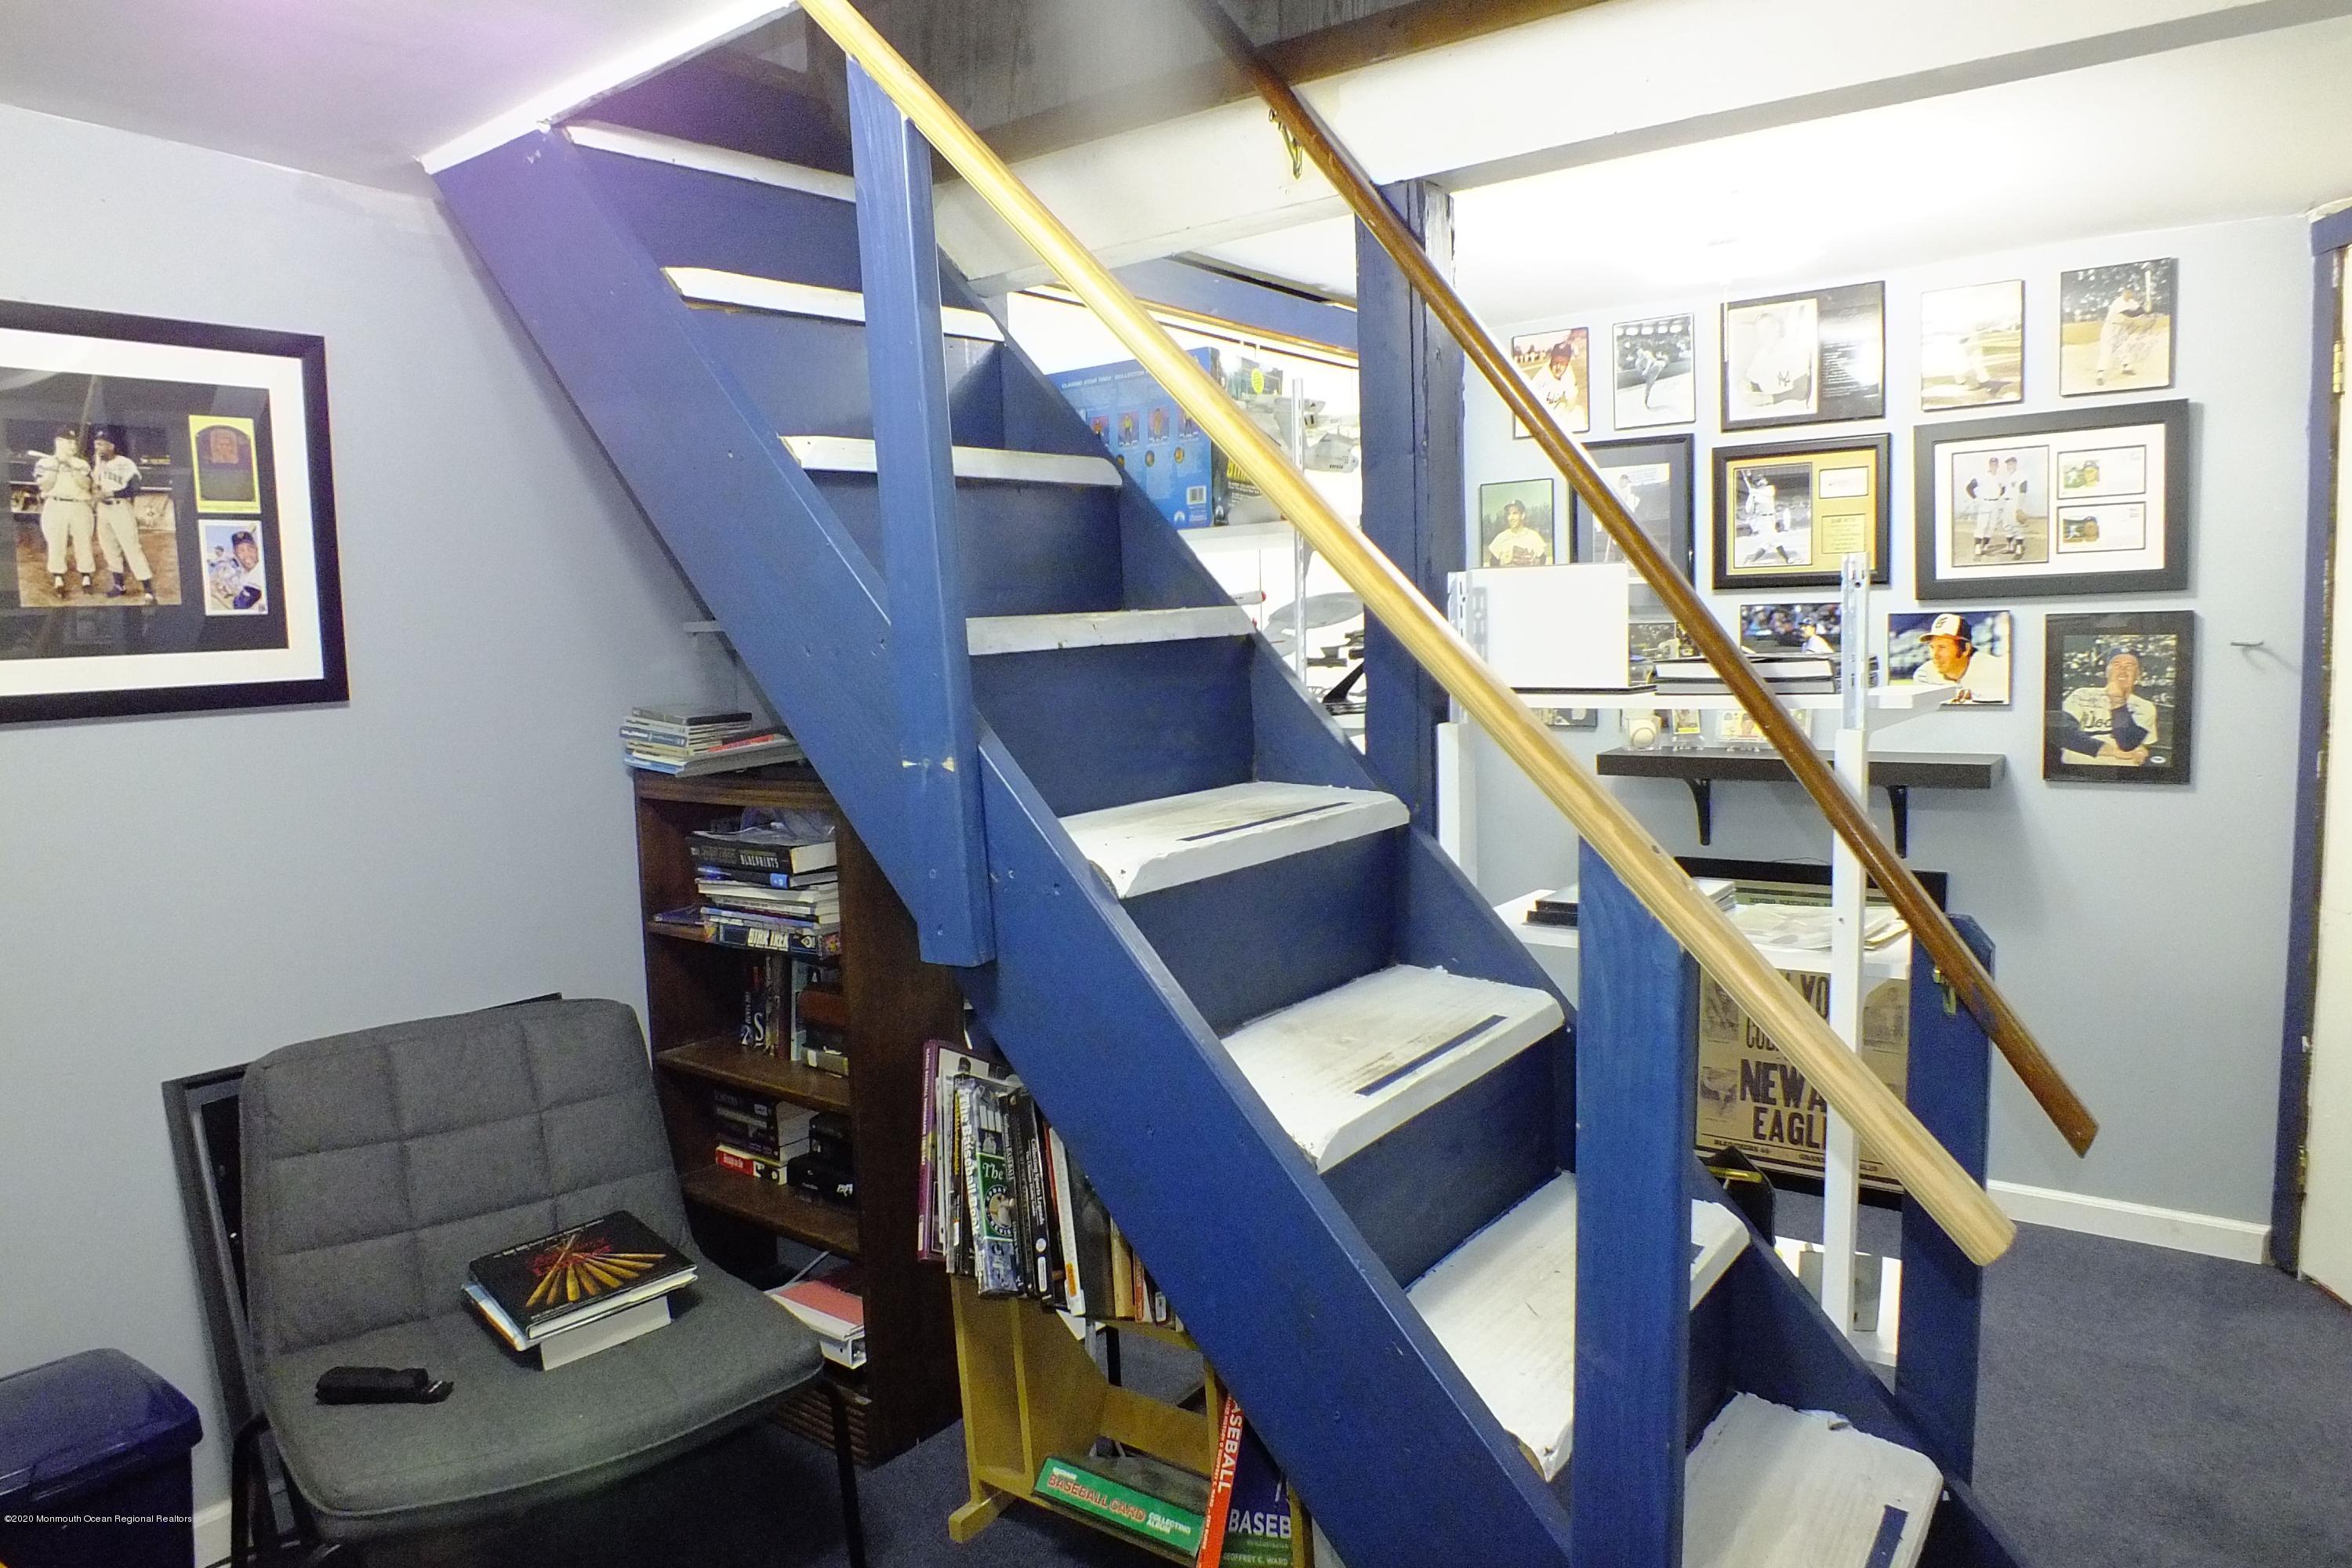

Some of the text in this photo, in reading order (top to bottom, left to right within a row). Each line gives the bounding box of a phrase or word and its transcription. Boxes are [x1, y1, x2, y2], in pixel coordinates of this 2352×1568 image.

[747, 927, 789, 951] STAR TREK
[958, 1088, 980, 1236] The Baseball Book
[982, 1162, 1004, 1180] The
[1047, 1473, 1108, 1508] BASEBALL
[1109, 1498, 1146, 1523] CARD
[1146, 1518, 1171, 1534] ALBUM
[1149, 1512, 1192, 1536] COLLECTING
